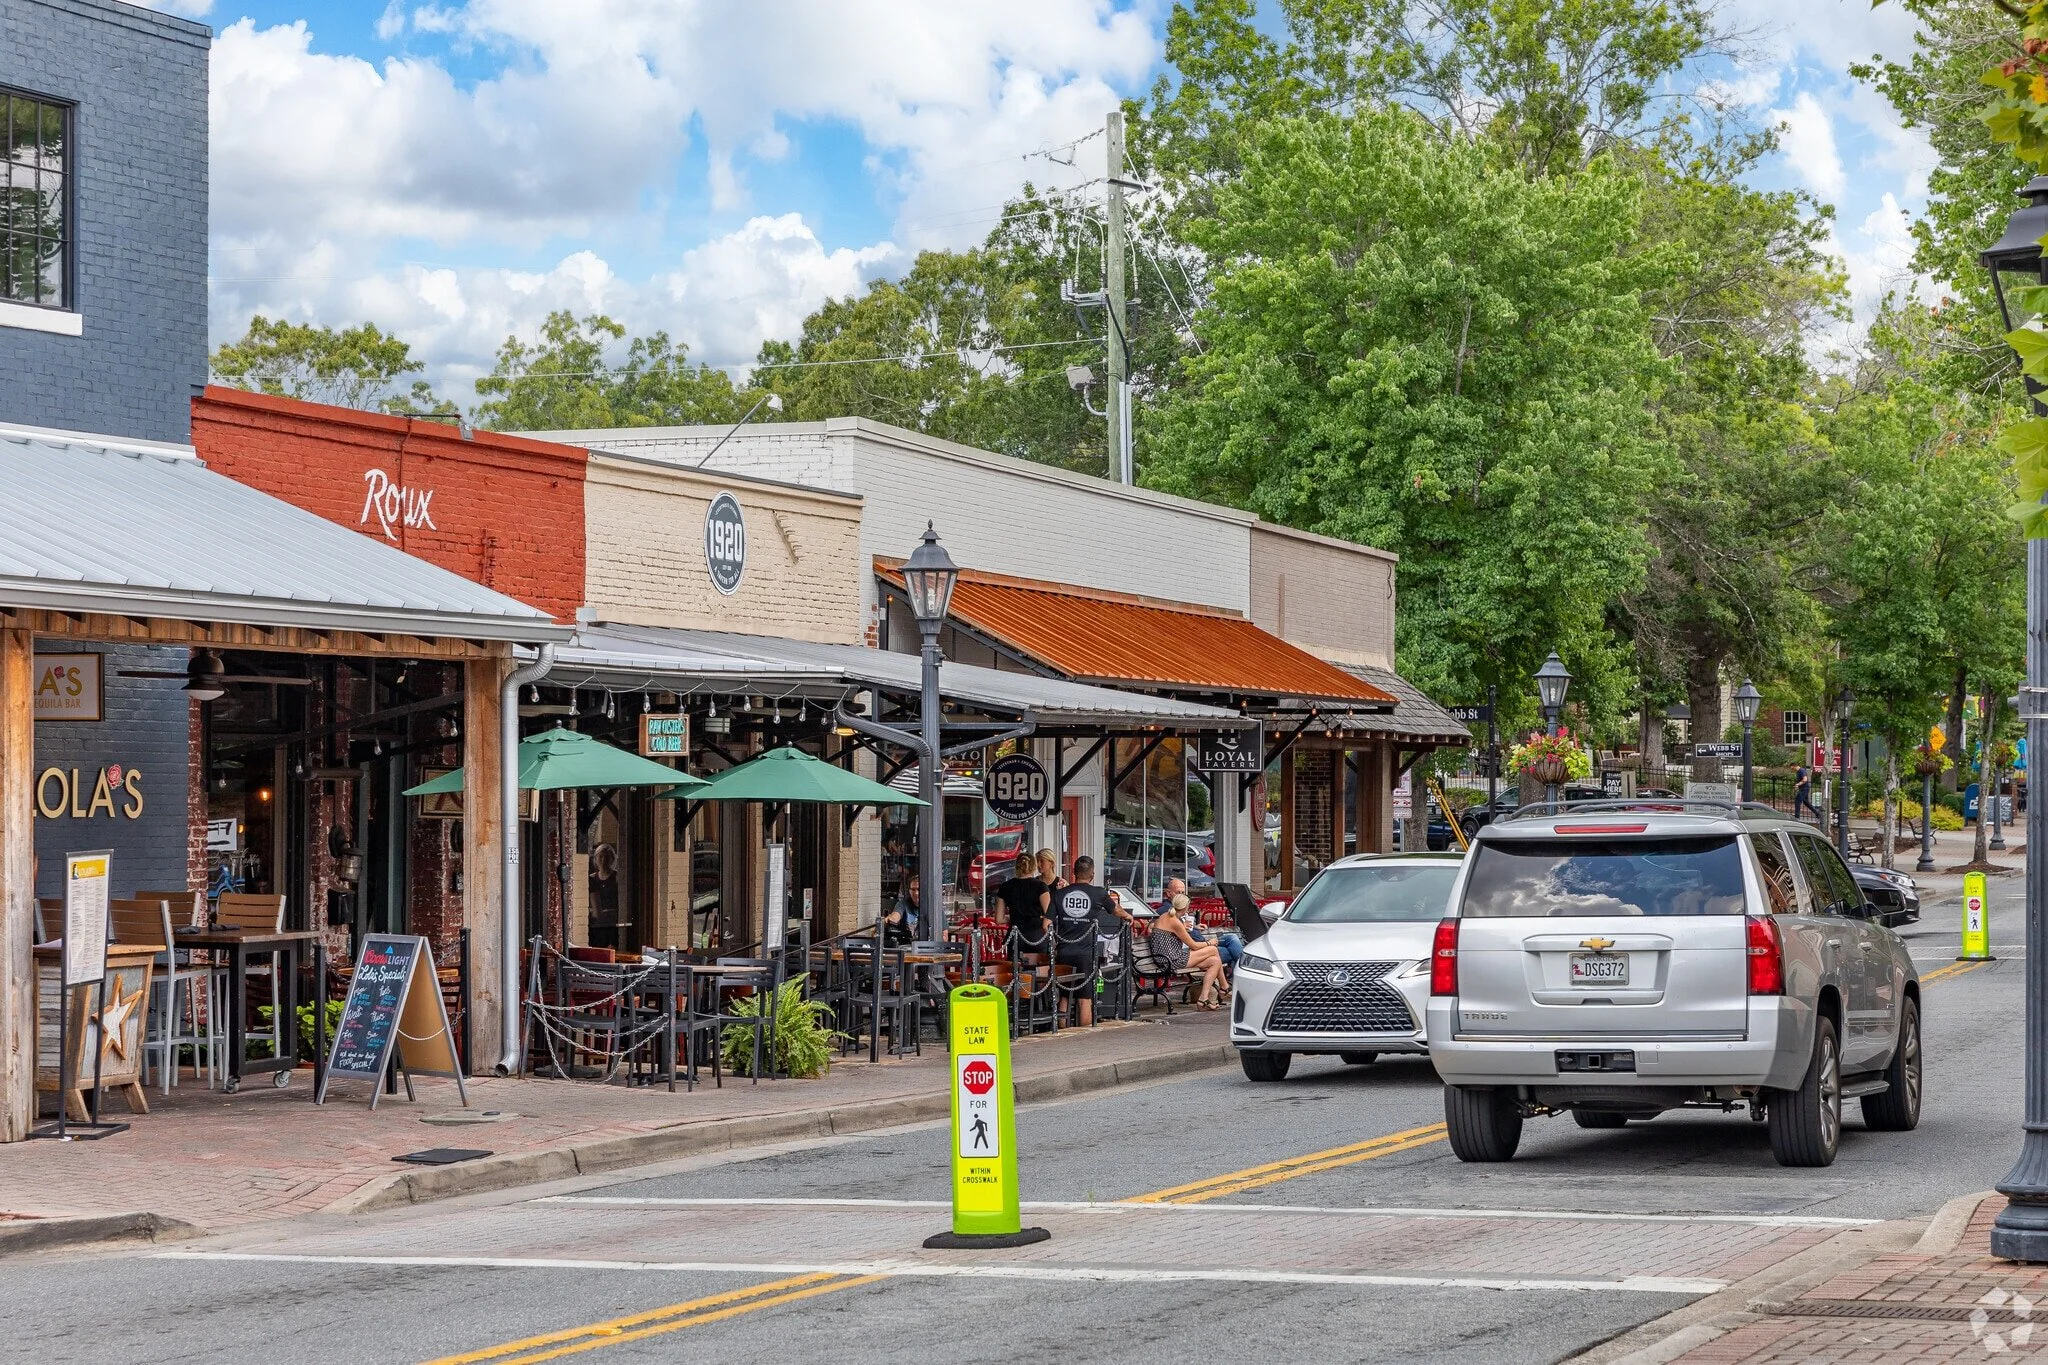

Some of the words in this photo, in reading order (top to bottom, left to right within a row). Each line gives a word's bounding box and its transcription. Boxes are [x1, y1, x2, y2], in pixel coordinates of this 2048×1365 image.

[360, 468, 437, 541] Roux
[708, 519, 743, 562] 1920
[34, 699, 63, 709] EQUILA
[65, 699, 81, 709] BAR
[1468, 708, 1479, 720] St
[1205, 751, 1256, 762] LOYAL
[988, 772, 1044, 800] 1920
[1603, 785, 1622, 793] HERE
[1606, 779, 1621, 787] PAY
[34, 764, 144, 820] OLA'S
[1000, 809, 1018, 819] TAVERN
[1027, 807, 1037, 815] ALL
[1065, 897, 1089, 909] 1920
[363, 949, 388, 965] Coors
[387, 955, 410, 966] LIGHT
[377, 965, 407, 984] Specials
[1585, 962, 1624, 977] DSG372
[964, 1026, 989, 1035] STATE
[968, 1035, 985, 1045] LAW
[339, 1057, 353, 1068] FOOD
[964, 1071, 993, 1086] STOP
[970, 1100, 987, 1109] FOR
[970, 1167, 991, 1175] WITHIN
[962, 1175, 998, 1184] CROSSWALK
